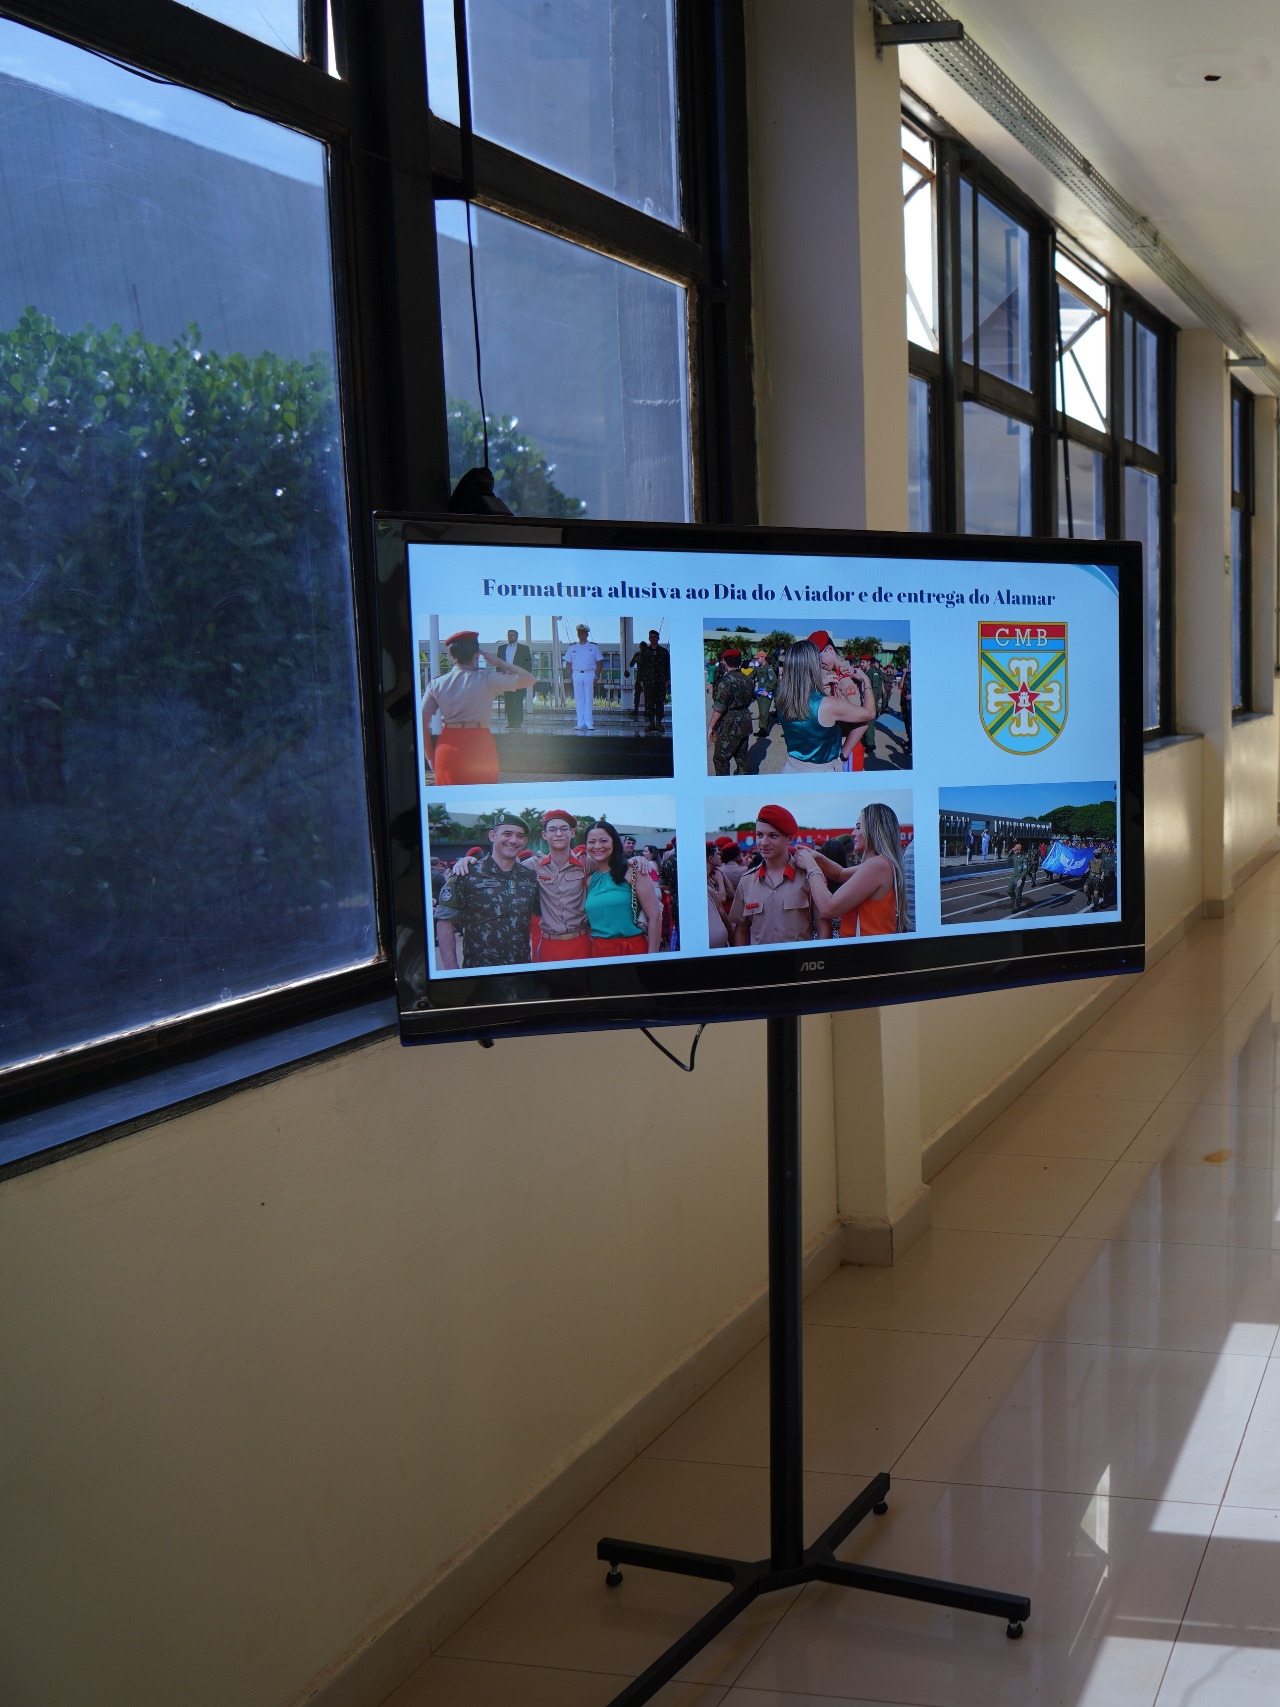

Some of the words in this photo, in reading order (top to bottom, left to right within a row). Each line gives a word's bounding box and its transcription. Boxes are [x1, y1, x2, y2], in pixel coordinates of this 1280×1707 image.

[482, 579, 604, 598] Formatura
[608, 581, 682, 599] alusiva
[685, 588, 710, 600] ao
[713, 583, 748, 601] Dia
[751, 584, 776, 601] do
[779, 585, 855, 602] Aviador
[858, 591, 868, 603] e
[872, 586, 894, 603] de
[897, 590, 965, 608] entrega
[969, 589, 990, 605] do
[993, 590, 1056, 606] Alamar
[995, 628, 1049, 647] CMB
[800, 961, 825, 971] AOC
